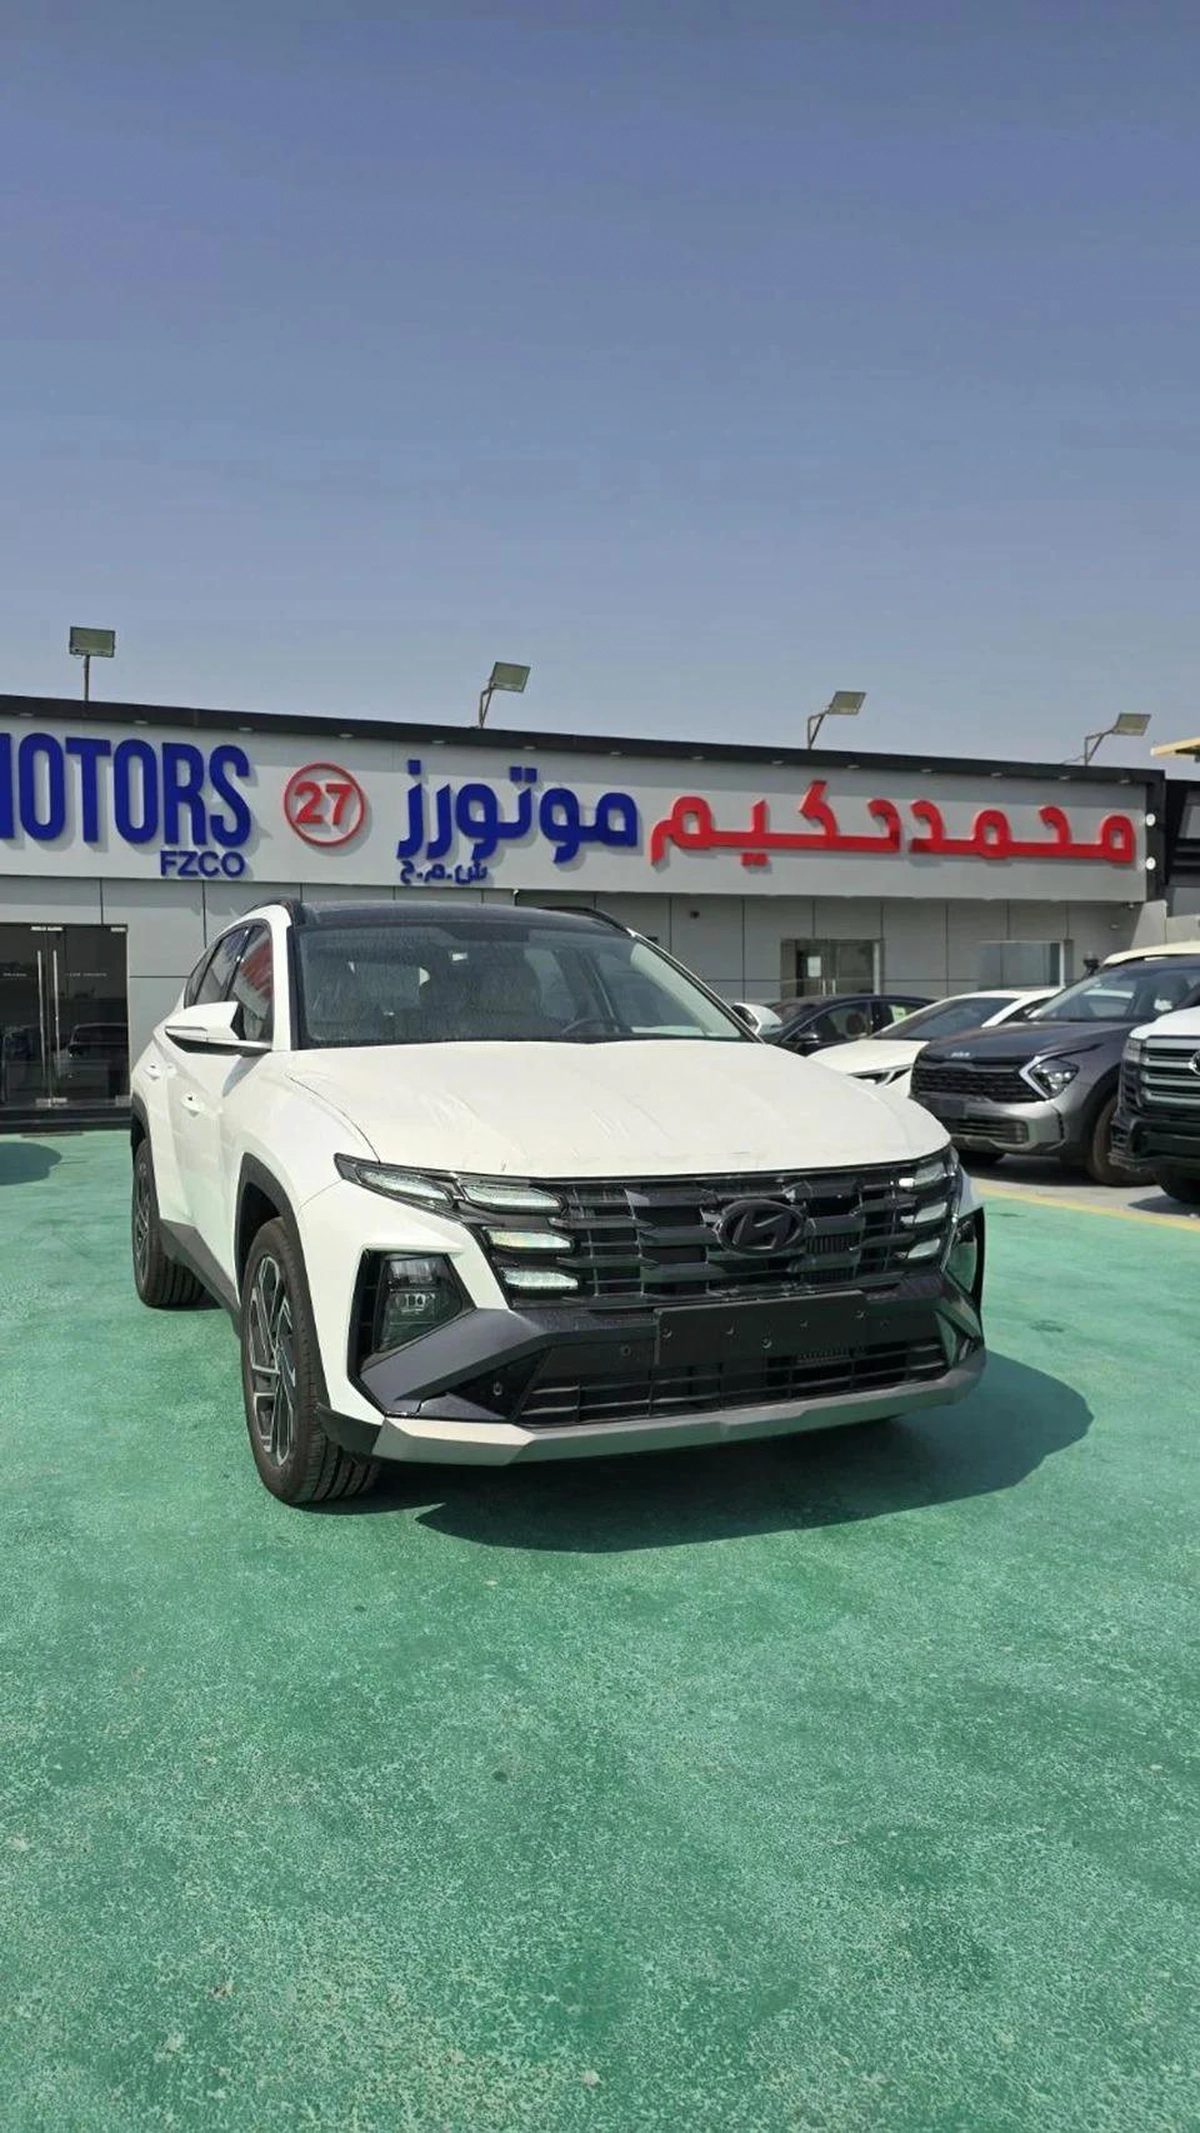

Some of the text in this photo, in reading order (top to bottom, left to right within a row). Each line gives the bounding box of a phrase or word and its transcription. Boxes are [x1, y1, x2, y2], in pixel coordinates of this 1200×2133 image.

[294, 780, 353, 826] 27
[396, 759, 639, 864] موتورز
[160, 850, 245, 877] FZCO
